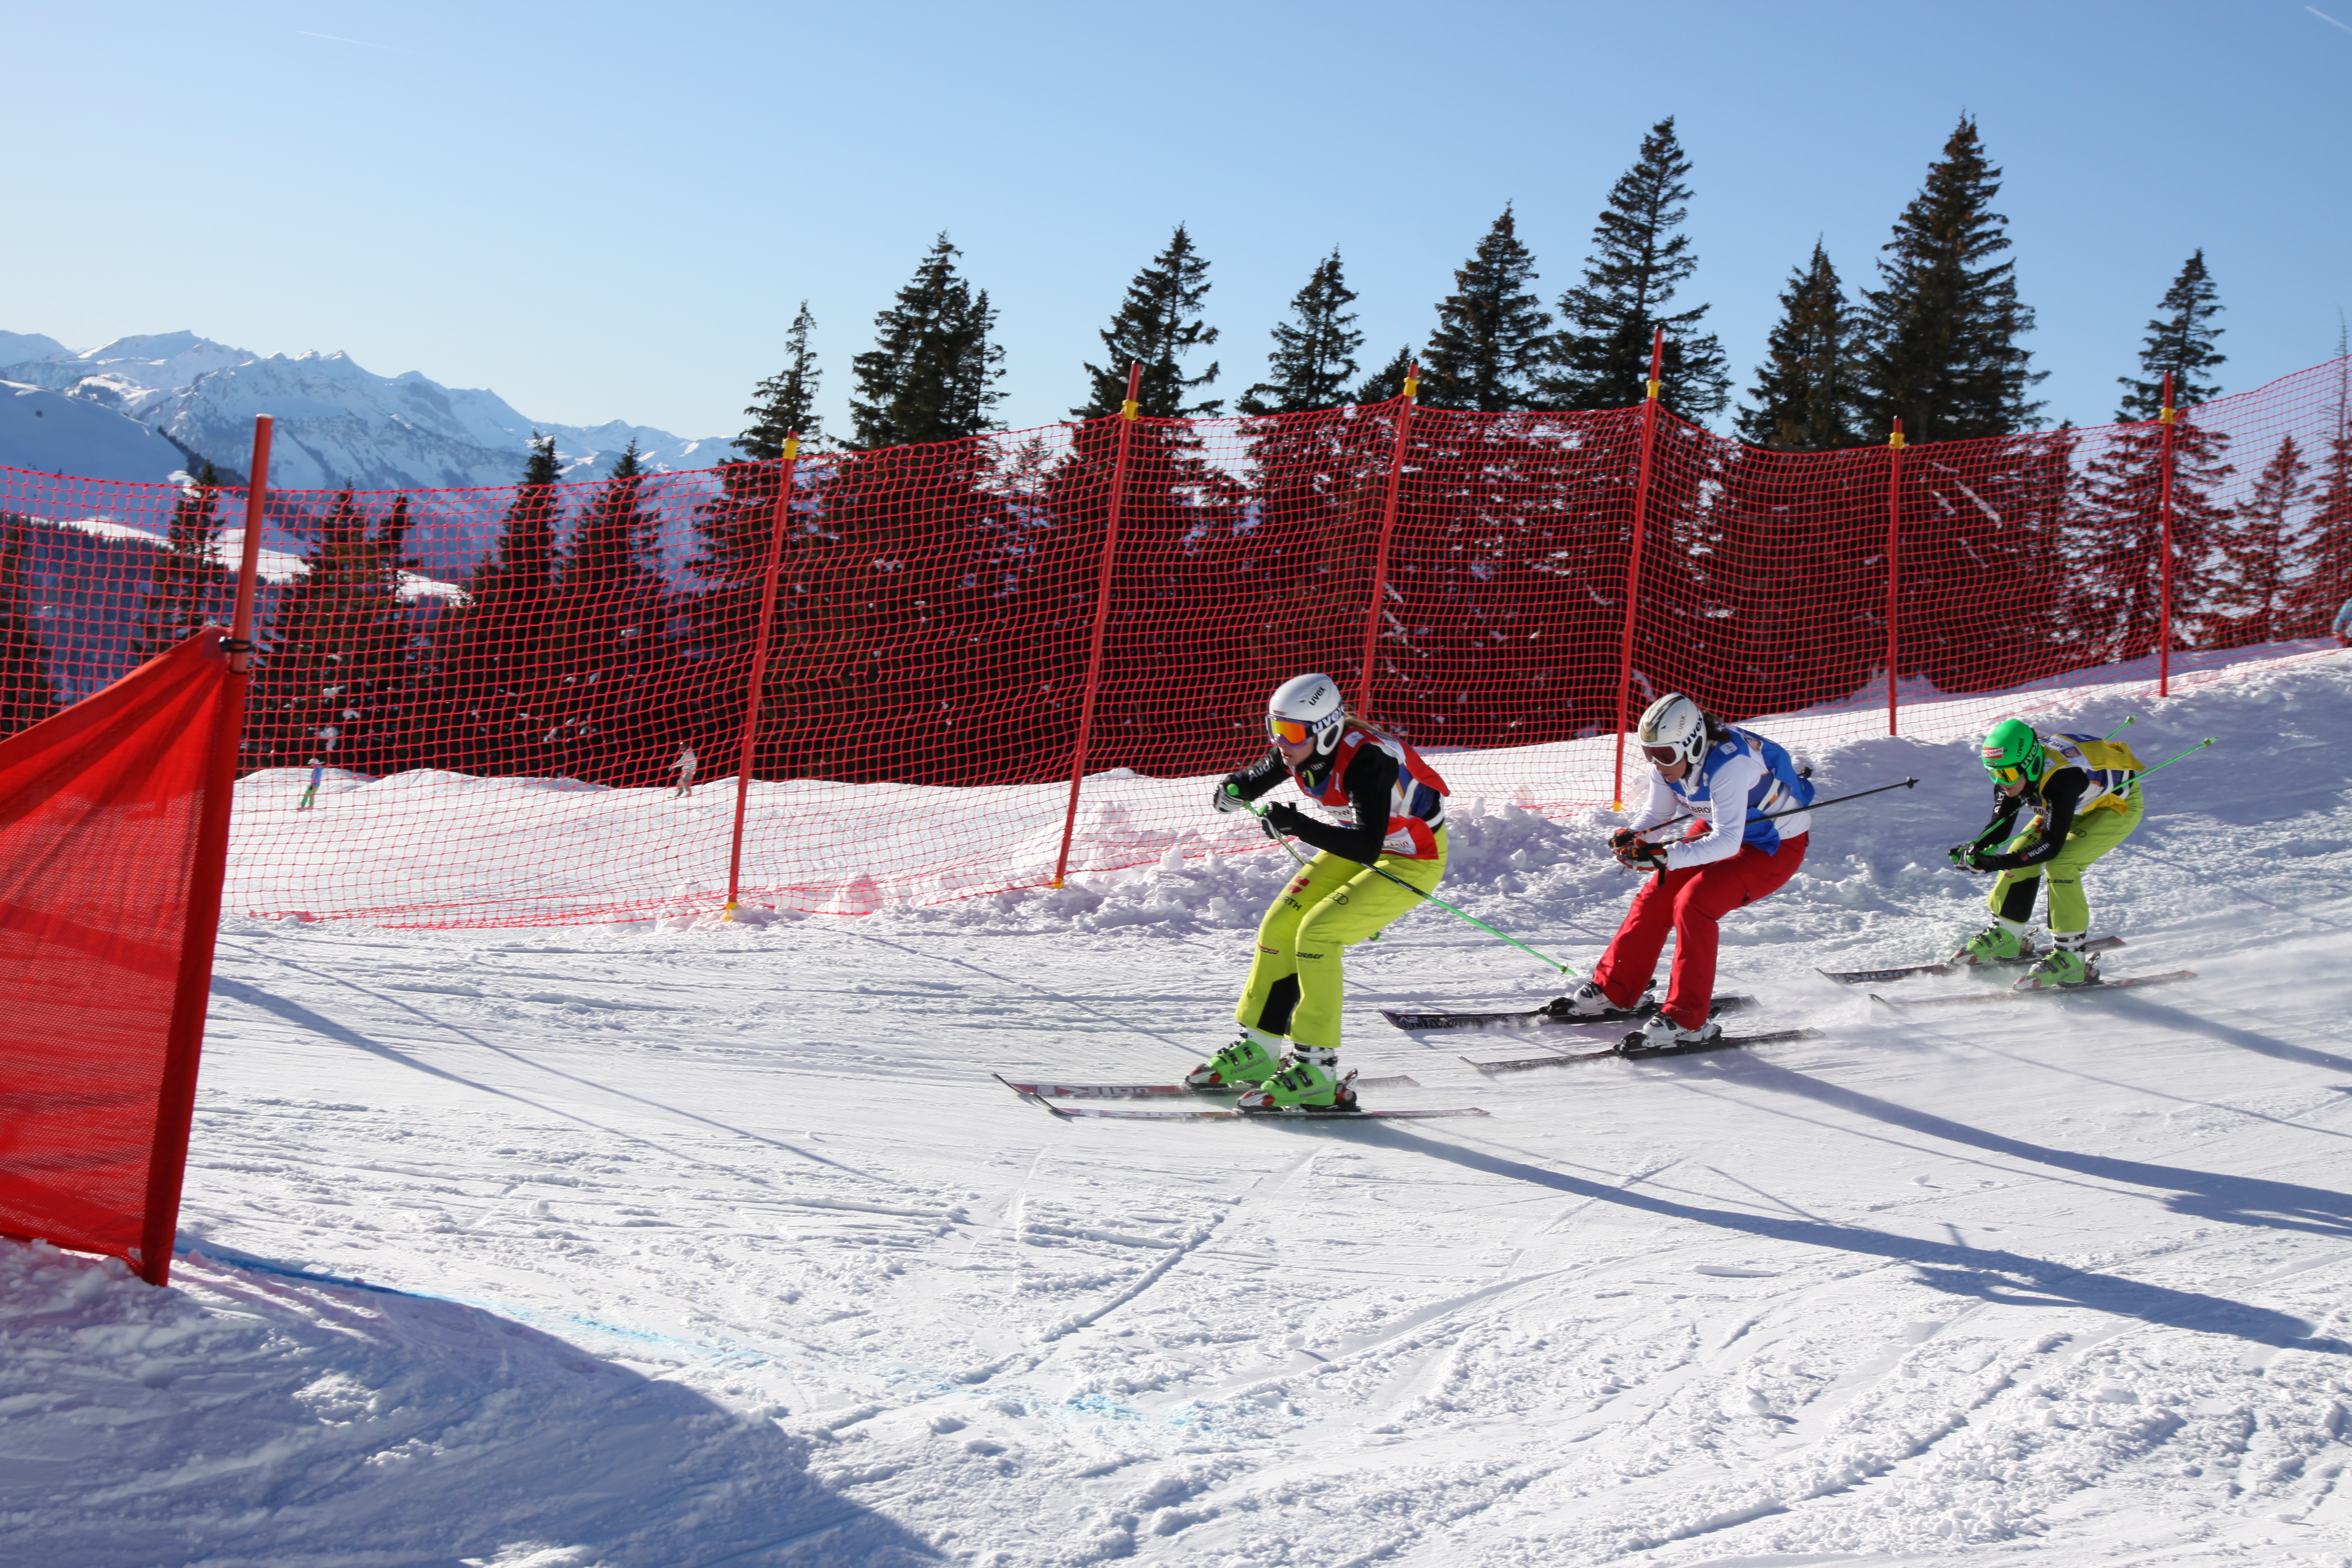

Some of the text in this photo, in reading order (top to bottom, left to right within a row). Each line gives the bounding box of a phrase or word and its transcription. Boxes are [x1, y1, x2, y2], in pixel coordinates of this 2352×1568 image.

[1308, 686, 1326, 706] uvex
[1676, 714, 1686, 736] uvex
[1682, 717, 1703, 747] uvex
[2016, 737, 2025, 757] uvex
[2020, 741, 2039, 769] uvex
